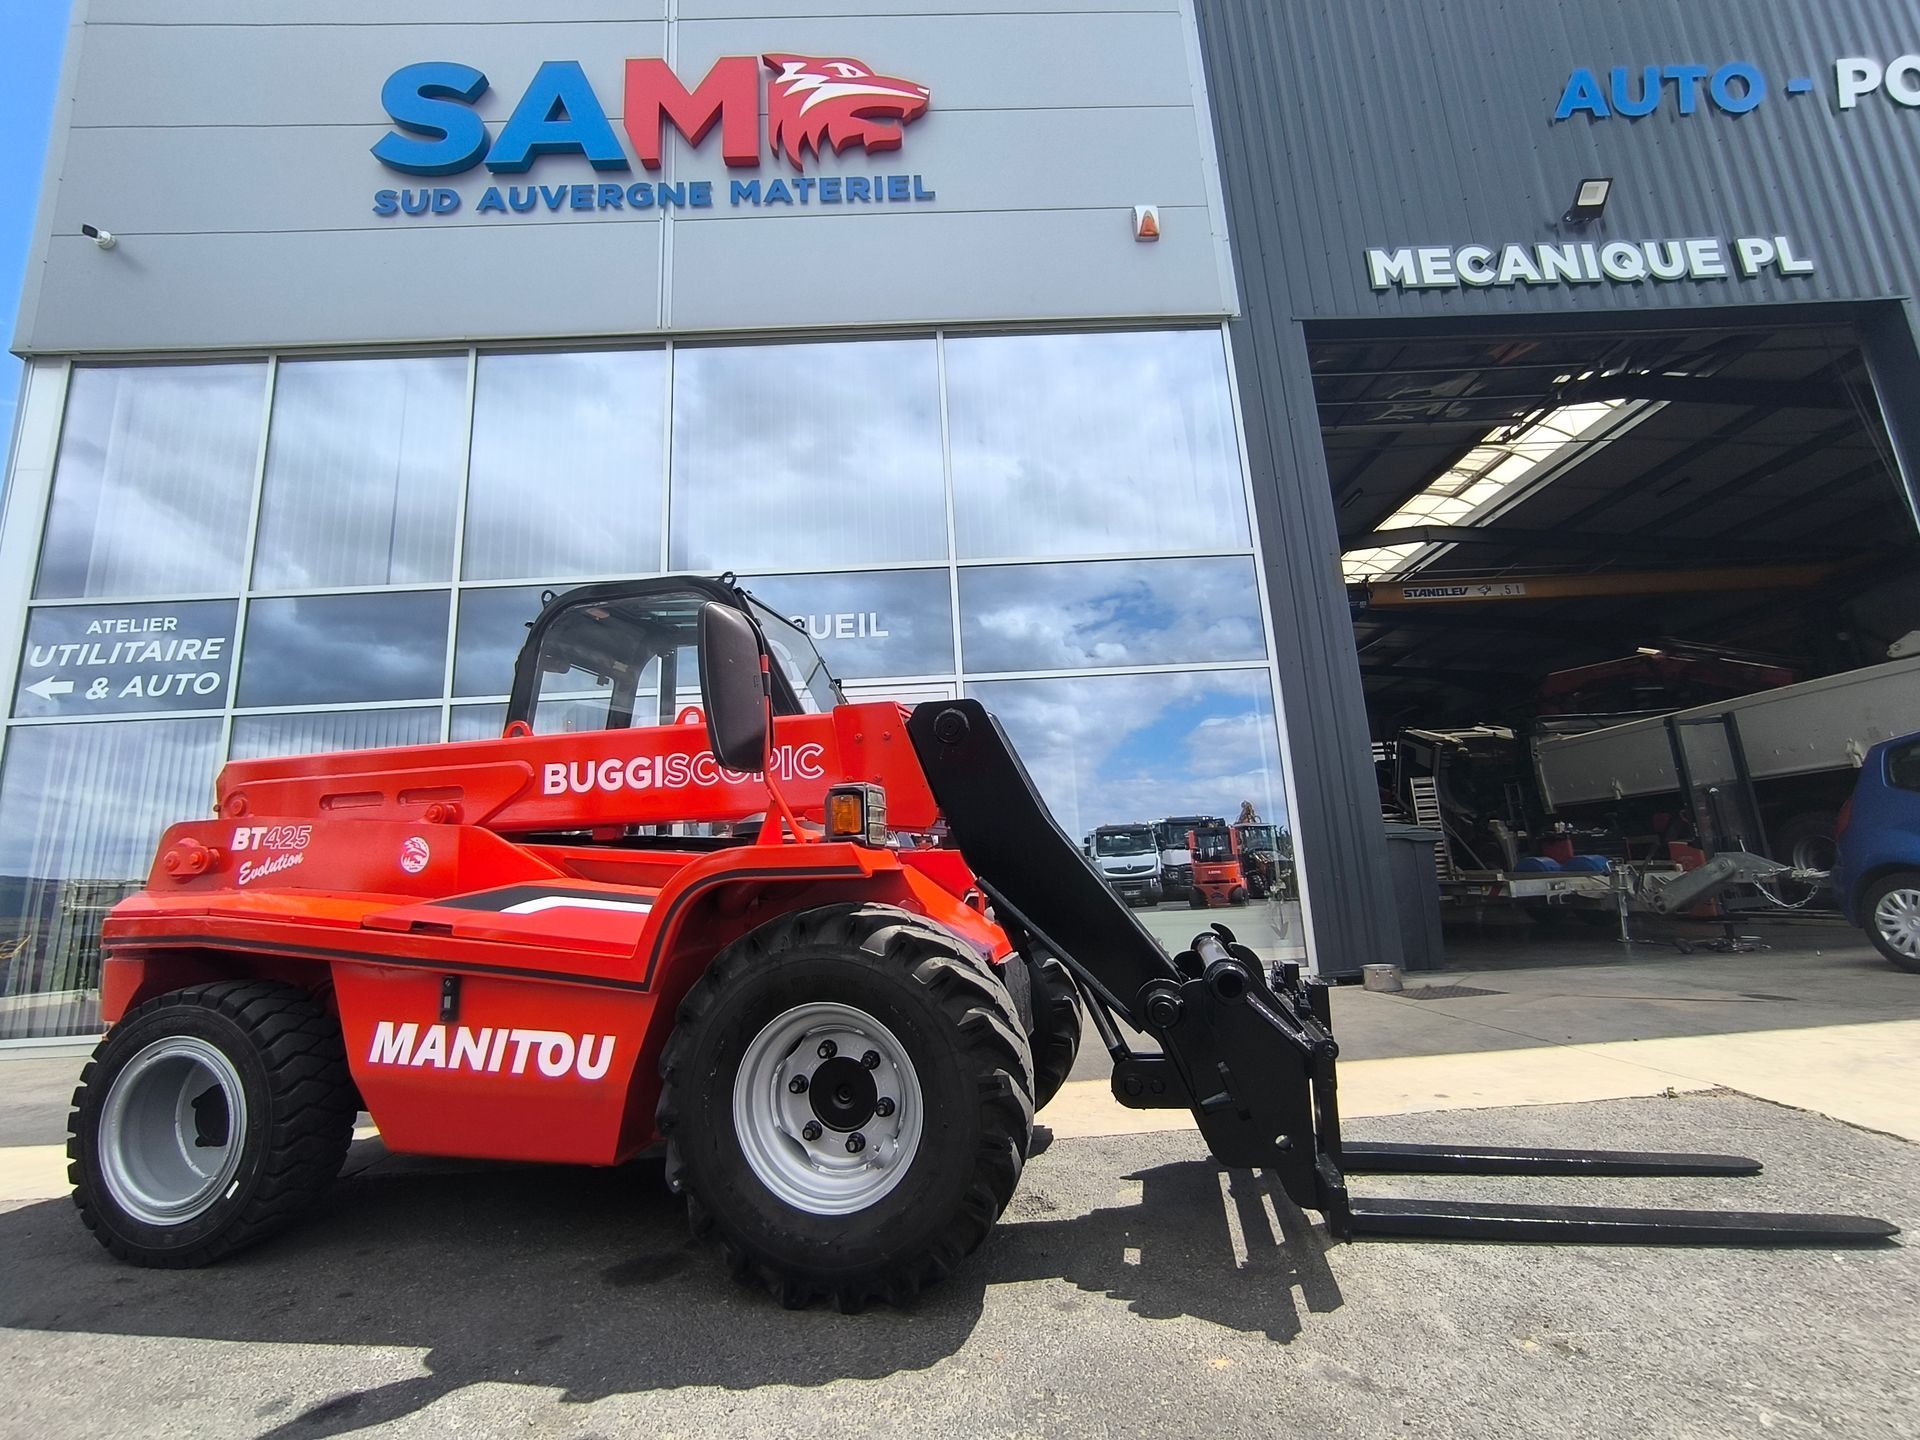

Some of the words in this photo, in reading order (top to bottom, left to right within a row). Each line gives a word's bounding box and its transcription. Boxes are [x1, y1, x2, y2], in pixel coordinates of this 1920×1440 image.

[1554, 61, 1768, 119] AUTO
[370, 55, 760, 177] SAM
[372, 188, 462, 216] SUD
[476, 180, 714, 213] AUVERGNE
[730, 174, 936, 205] MATERIEL
[1366, 240, 1729, 289] MECANIQUE
[1736, 236, 1815, 276] PL
[86, 617, 178, 635] ATELIER
[29, 637, 225, 668] UTILITAIRE
[85, 677, 110, 700] &
[118, 671, 221, 699] AUTO
[231, 825, 313, 851] BT425
[237, 850, 304, 886] Evolution
[368, 1020, 617, 1080] MANITOU
